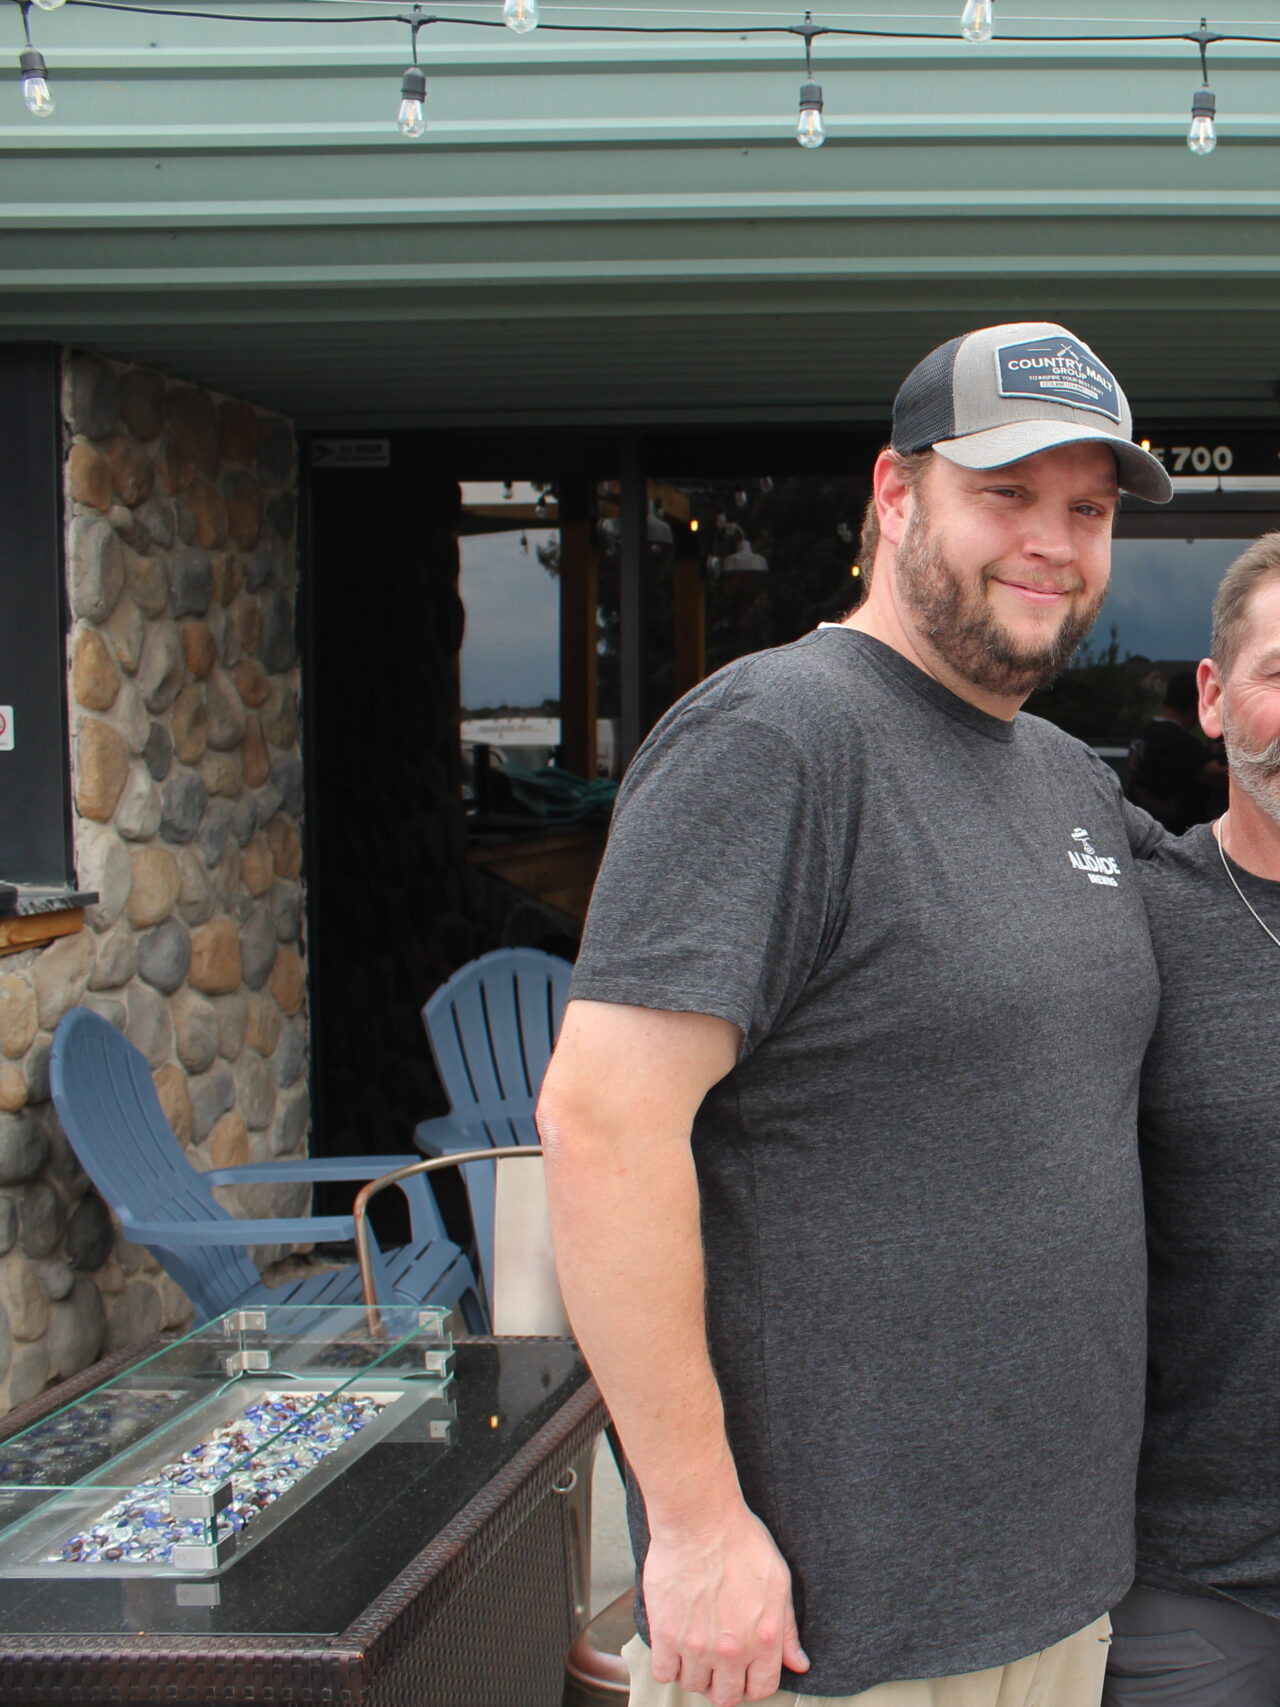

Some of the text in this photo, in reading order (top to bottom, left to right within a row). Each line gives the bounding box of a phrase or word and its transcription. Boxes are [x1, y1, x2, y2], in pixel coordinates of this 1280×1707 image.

[1008, 357, 1082, 371] COUNTRY
[1086, 366, 1113, 393] MALT
[1052, 366, 1088, 380] GROUP
[1171, 446, 1233, 472] 700
